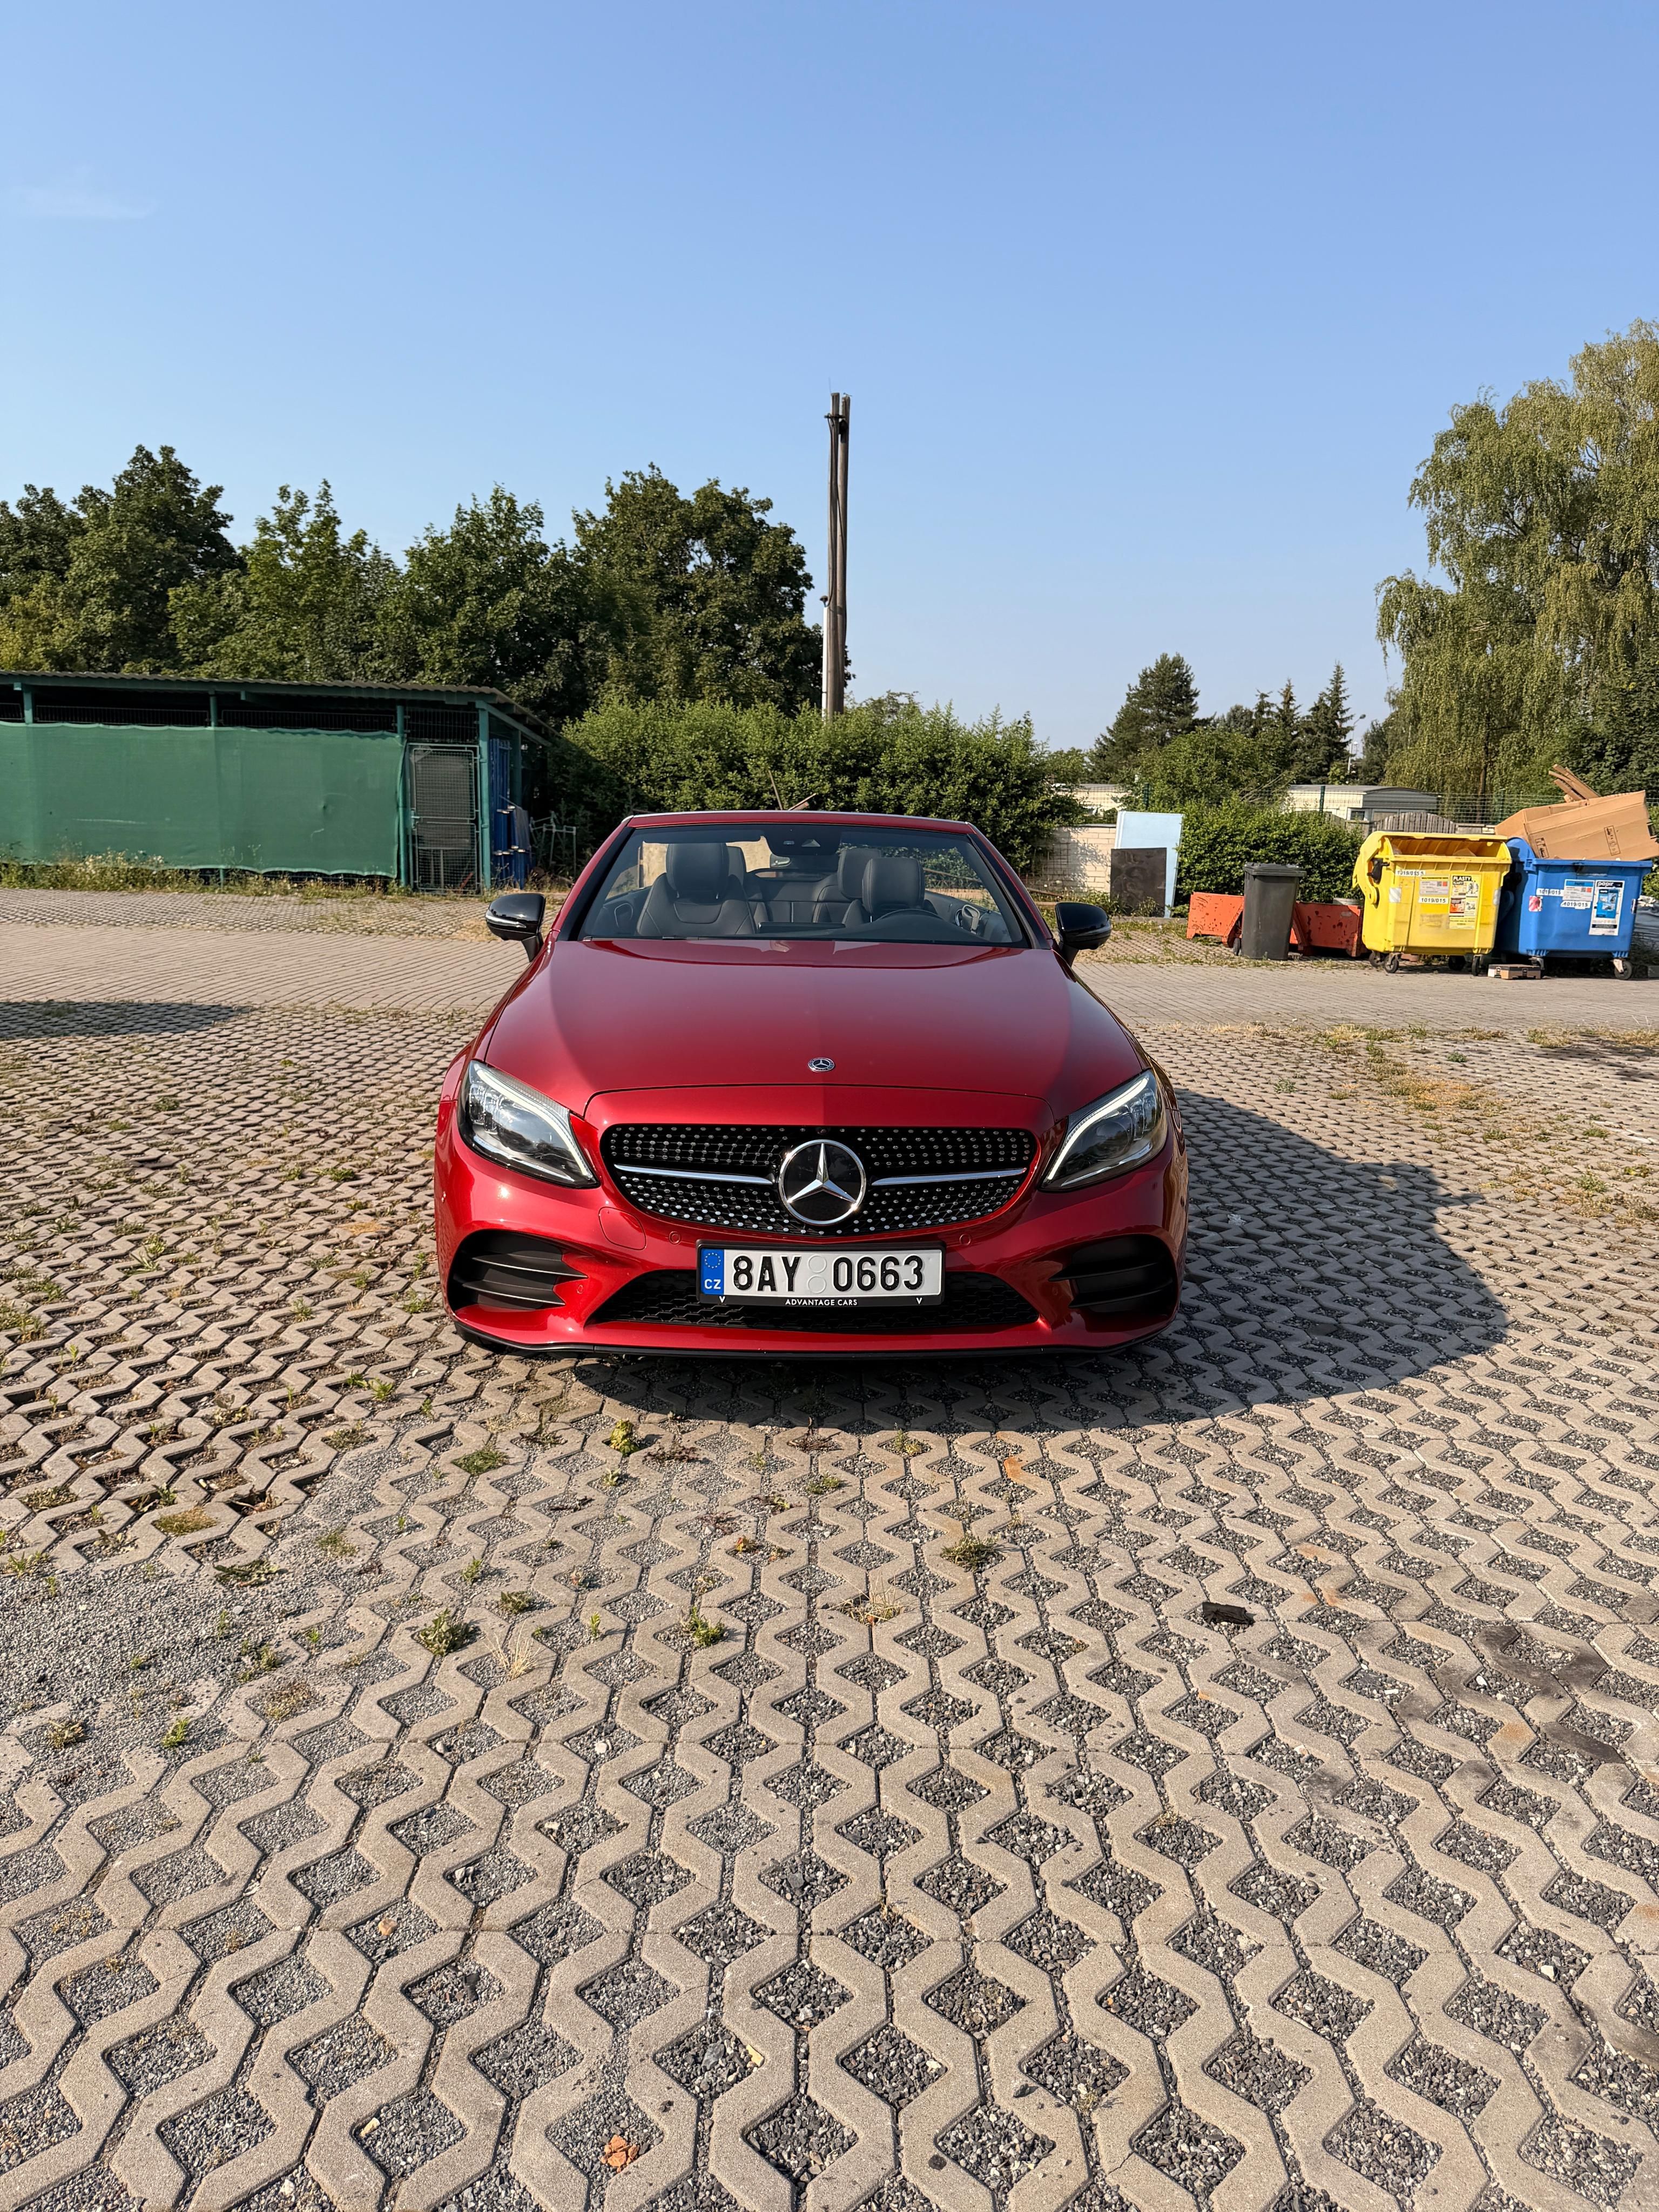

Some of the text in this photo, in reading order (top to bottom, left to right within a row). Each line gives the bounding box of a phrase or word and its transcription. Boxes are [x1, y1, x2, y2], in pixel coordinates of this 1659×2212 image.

[704, 1278, 721, 1290] CZ
[733, 1255, 923, 1292] 8AY 0663
